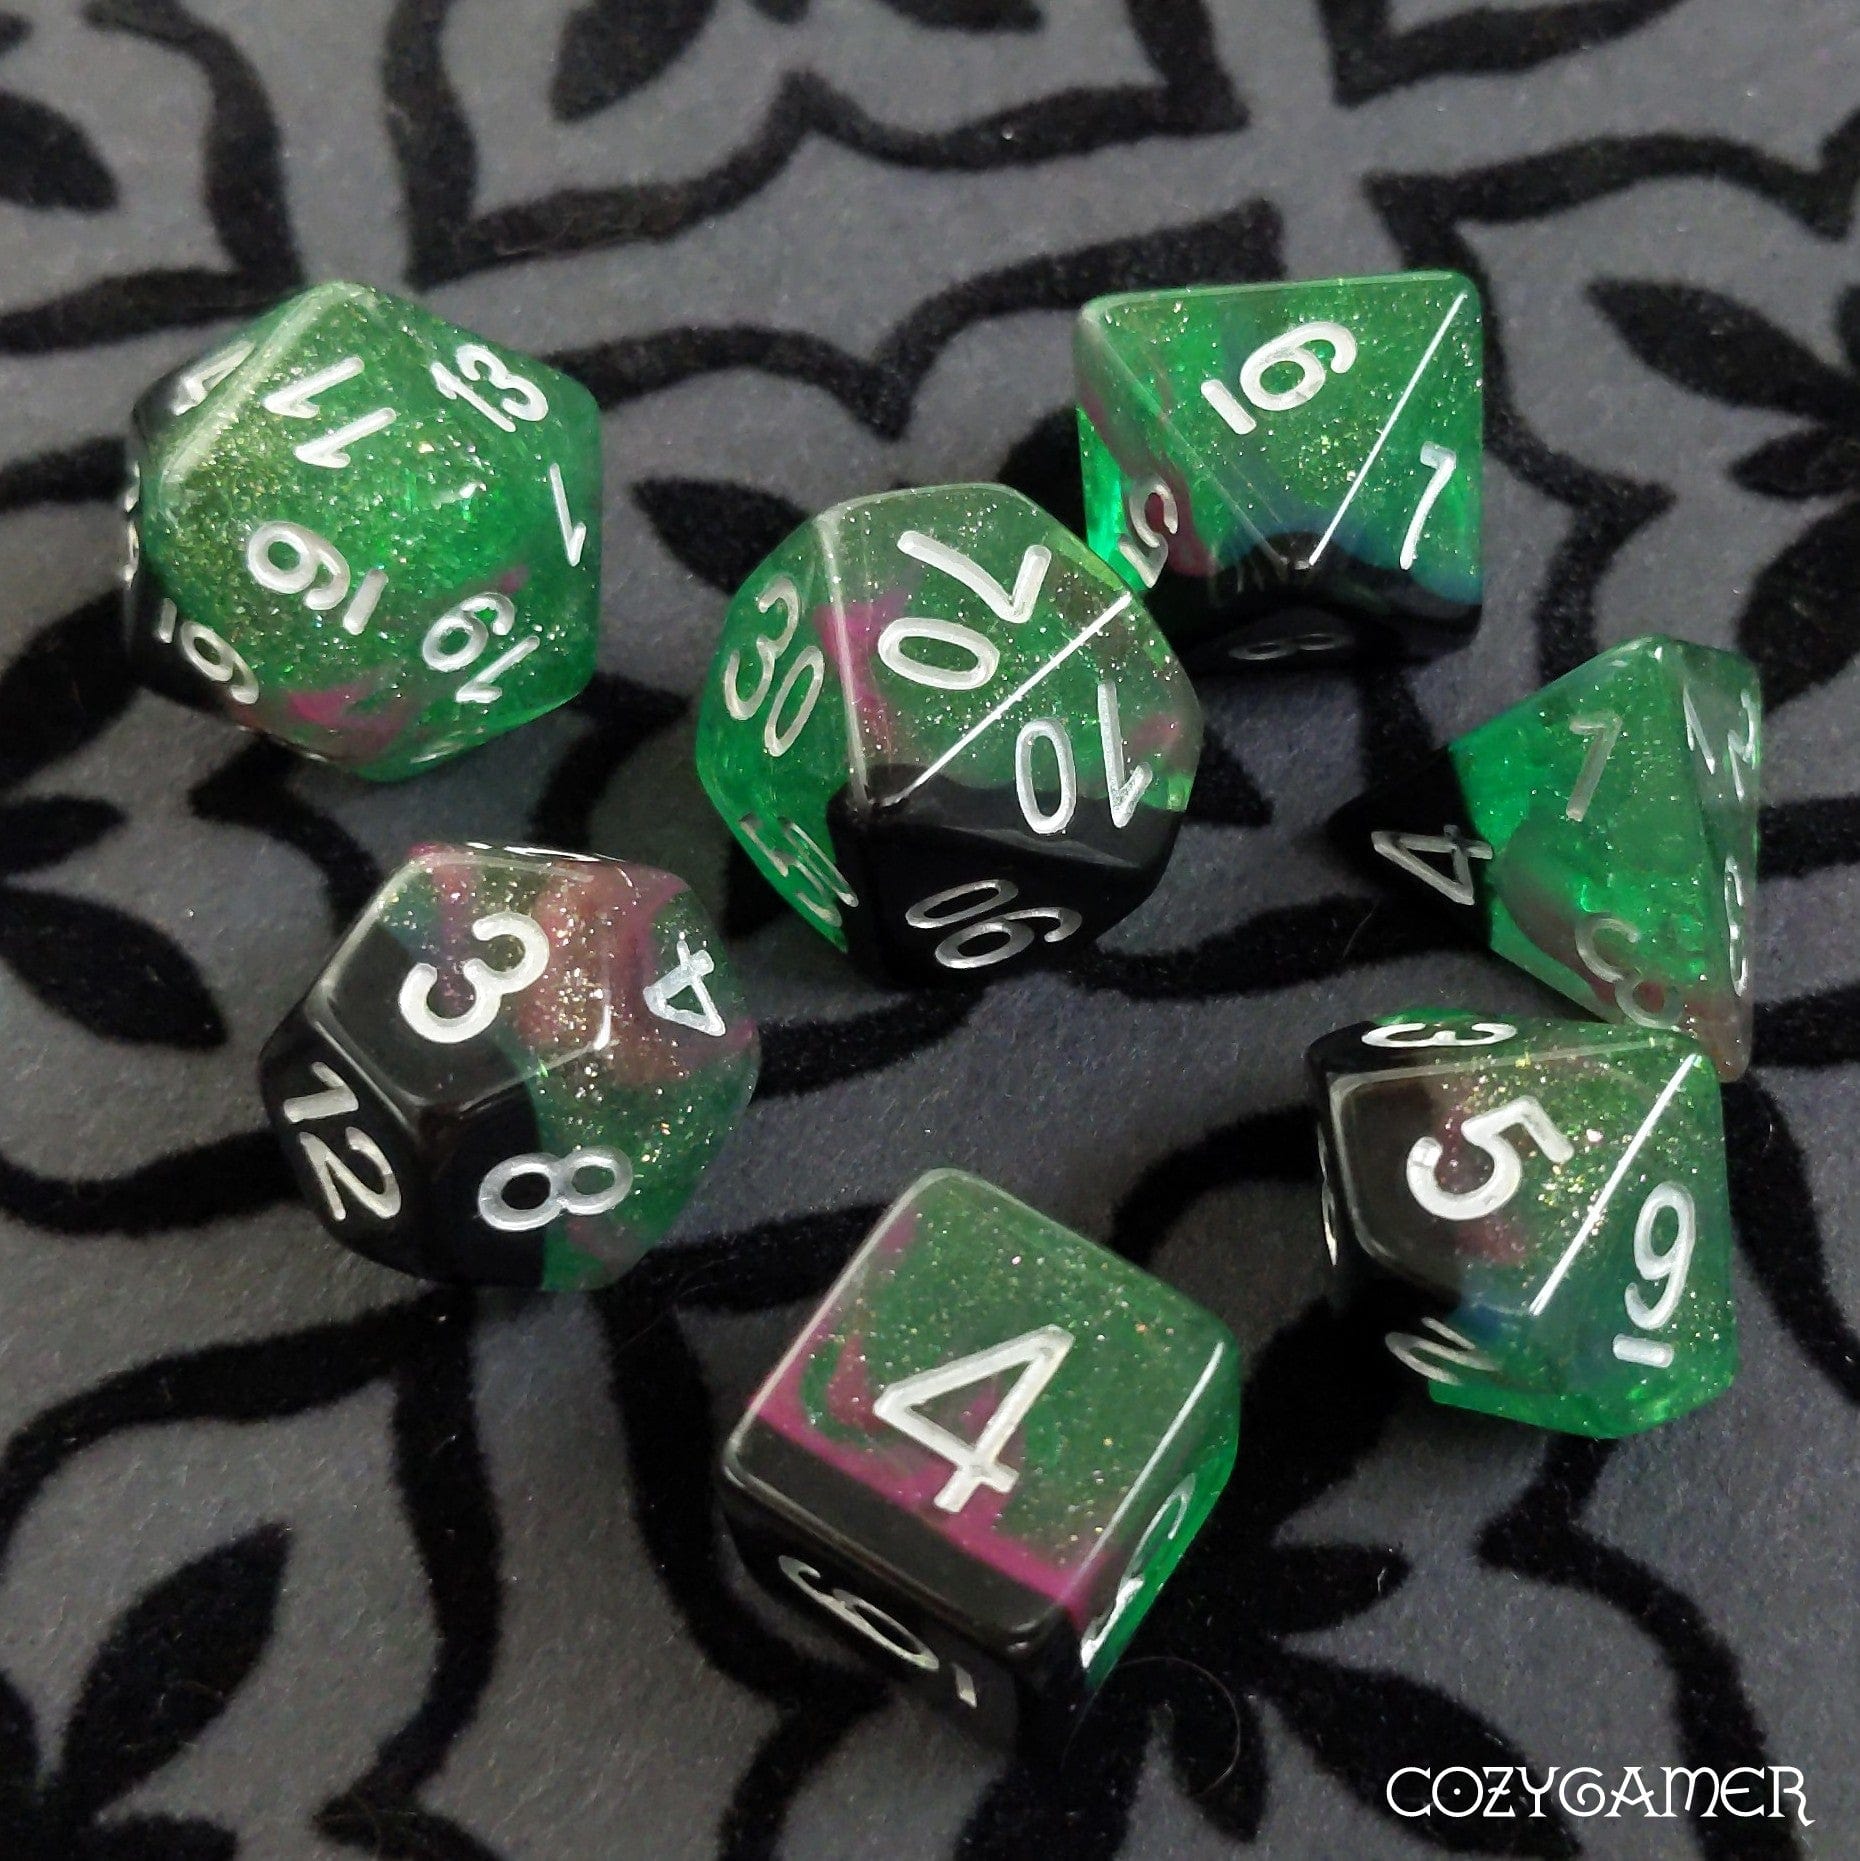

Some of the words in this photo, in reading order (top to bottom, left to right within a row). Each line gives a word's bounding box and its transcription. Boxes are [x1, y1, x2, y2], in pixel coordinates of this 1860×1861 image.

[261, 356, 397, 468] 11
[431, 343, 549, 433] 13
[1399, 440, 1457, 570] 7
[724, 575, 825, 757] 30
[877, 530, 1052, 691] 70
[1015, 681, 1153, 834] 10
[1371, 824, 1494, 906] 4
[398, 911, 550, 1044] 3
[643, 934, 726, 1036] 4
[283, 1061, 402, 1221] 12
[478, 1144, 634, 1232] 8
[1406, 1095, 1575, 1221] 5
[873, 1323, 1075, 1514] 4
